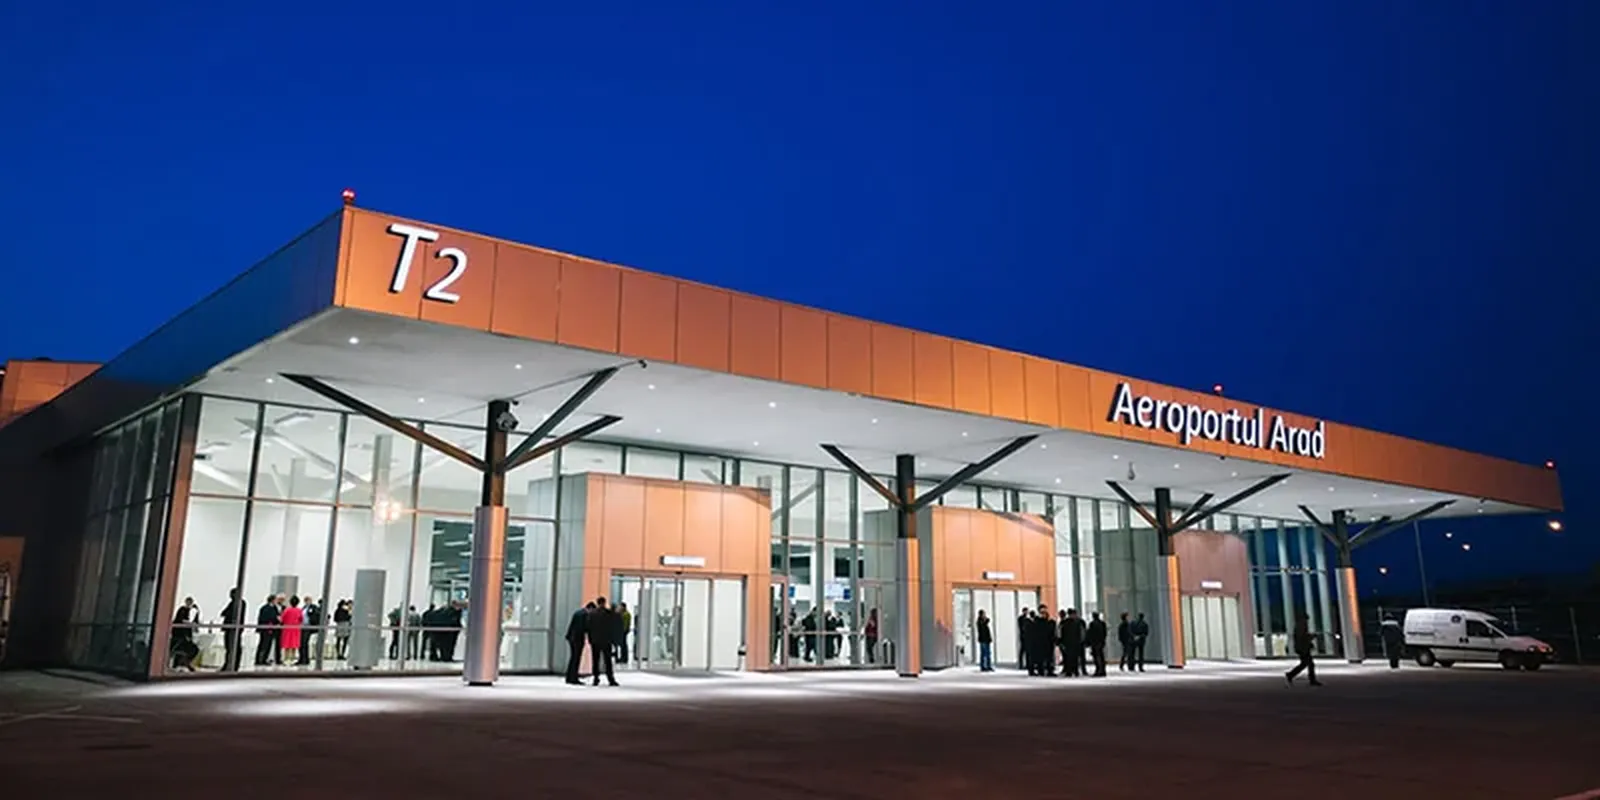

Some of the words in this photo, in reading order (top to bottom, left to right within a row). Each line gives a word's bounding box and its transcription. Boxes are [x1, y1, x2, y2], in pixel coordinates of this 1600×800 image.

[388, 223, 468, 303] T2
[1111, 382, 1265, 448] Aeroportul
[1269, 415, 1326, 459] Arad
